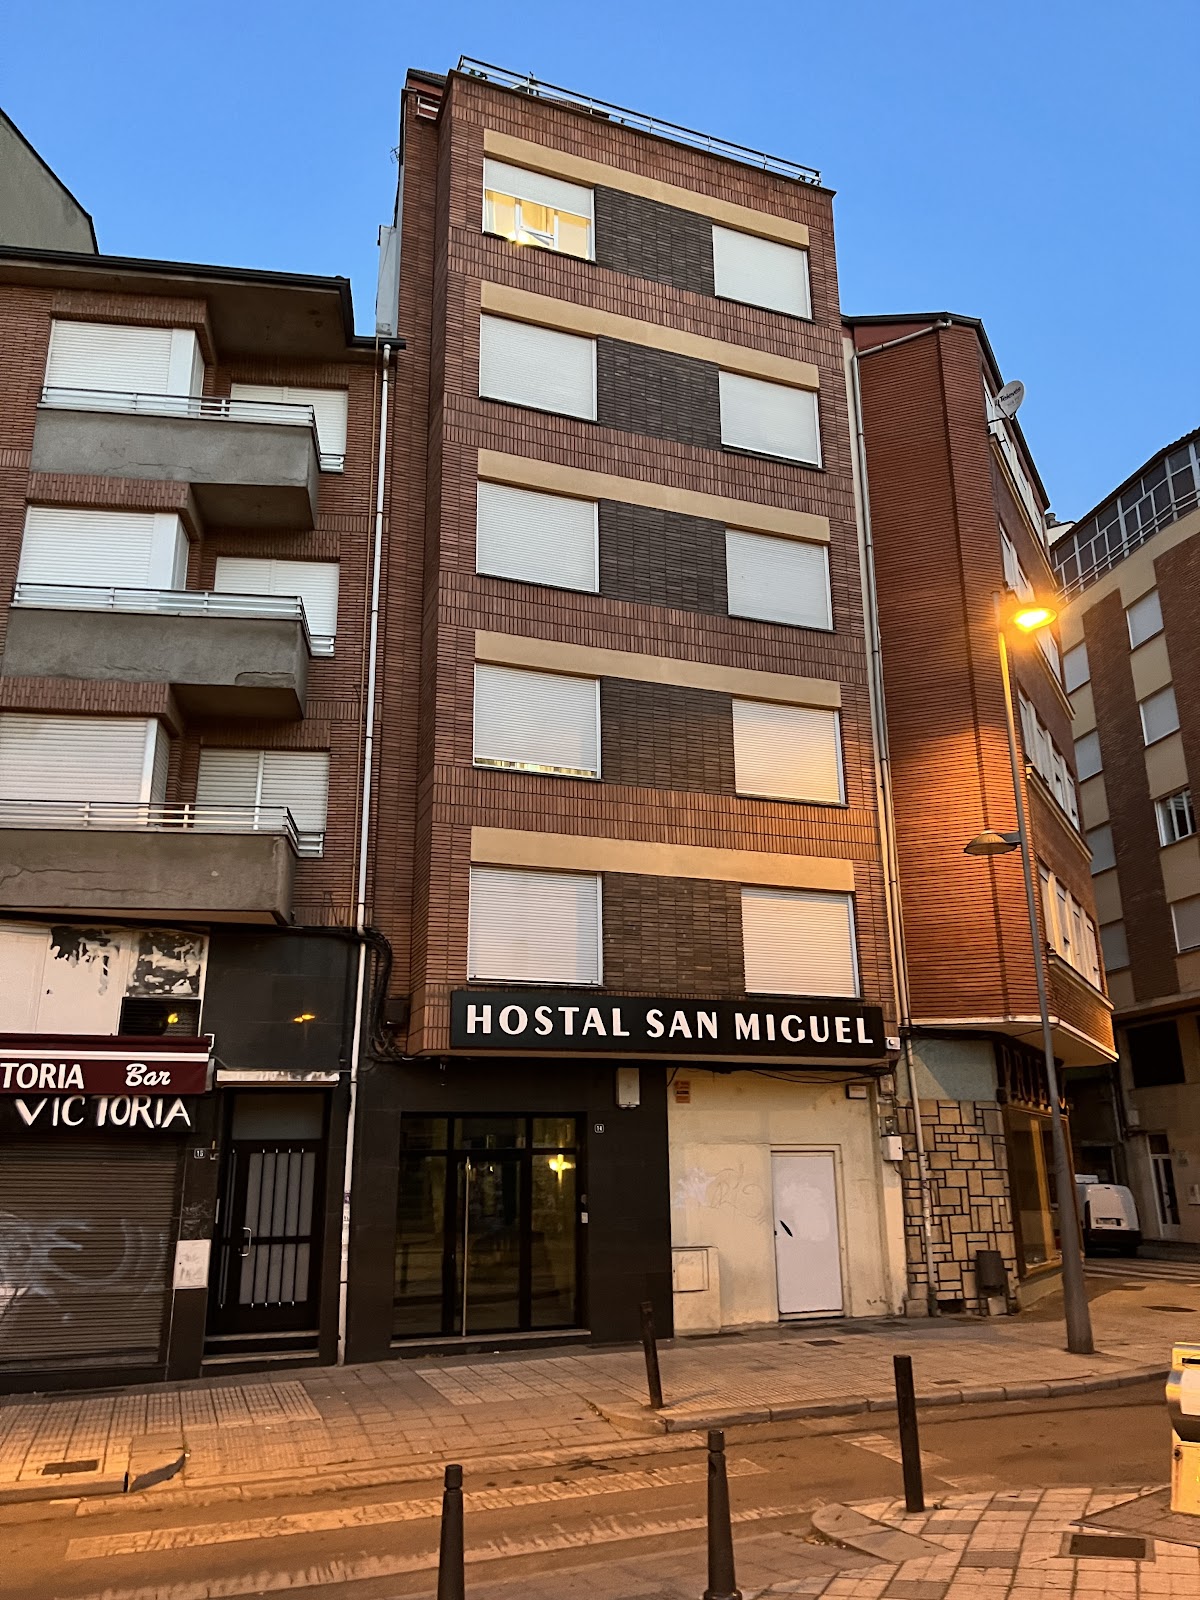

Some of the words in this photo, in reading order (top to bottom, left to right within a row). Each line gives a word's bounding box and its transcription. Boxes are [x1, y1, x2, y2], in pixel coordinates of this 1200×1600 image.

[466, 1004, 631, 1036] HOSTAL
[646, 1009, 719, 1039] SAN
[734, 1013, 874, 1044] MIGUEL
[125, 1063, 171, 1086] Bar
[15, 1095, 191, 1128] VICTORIA
